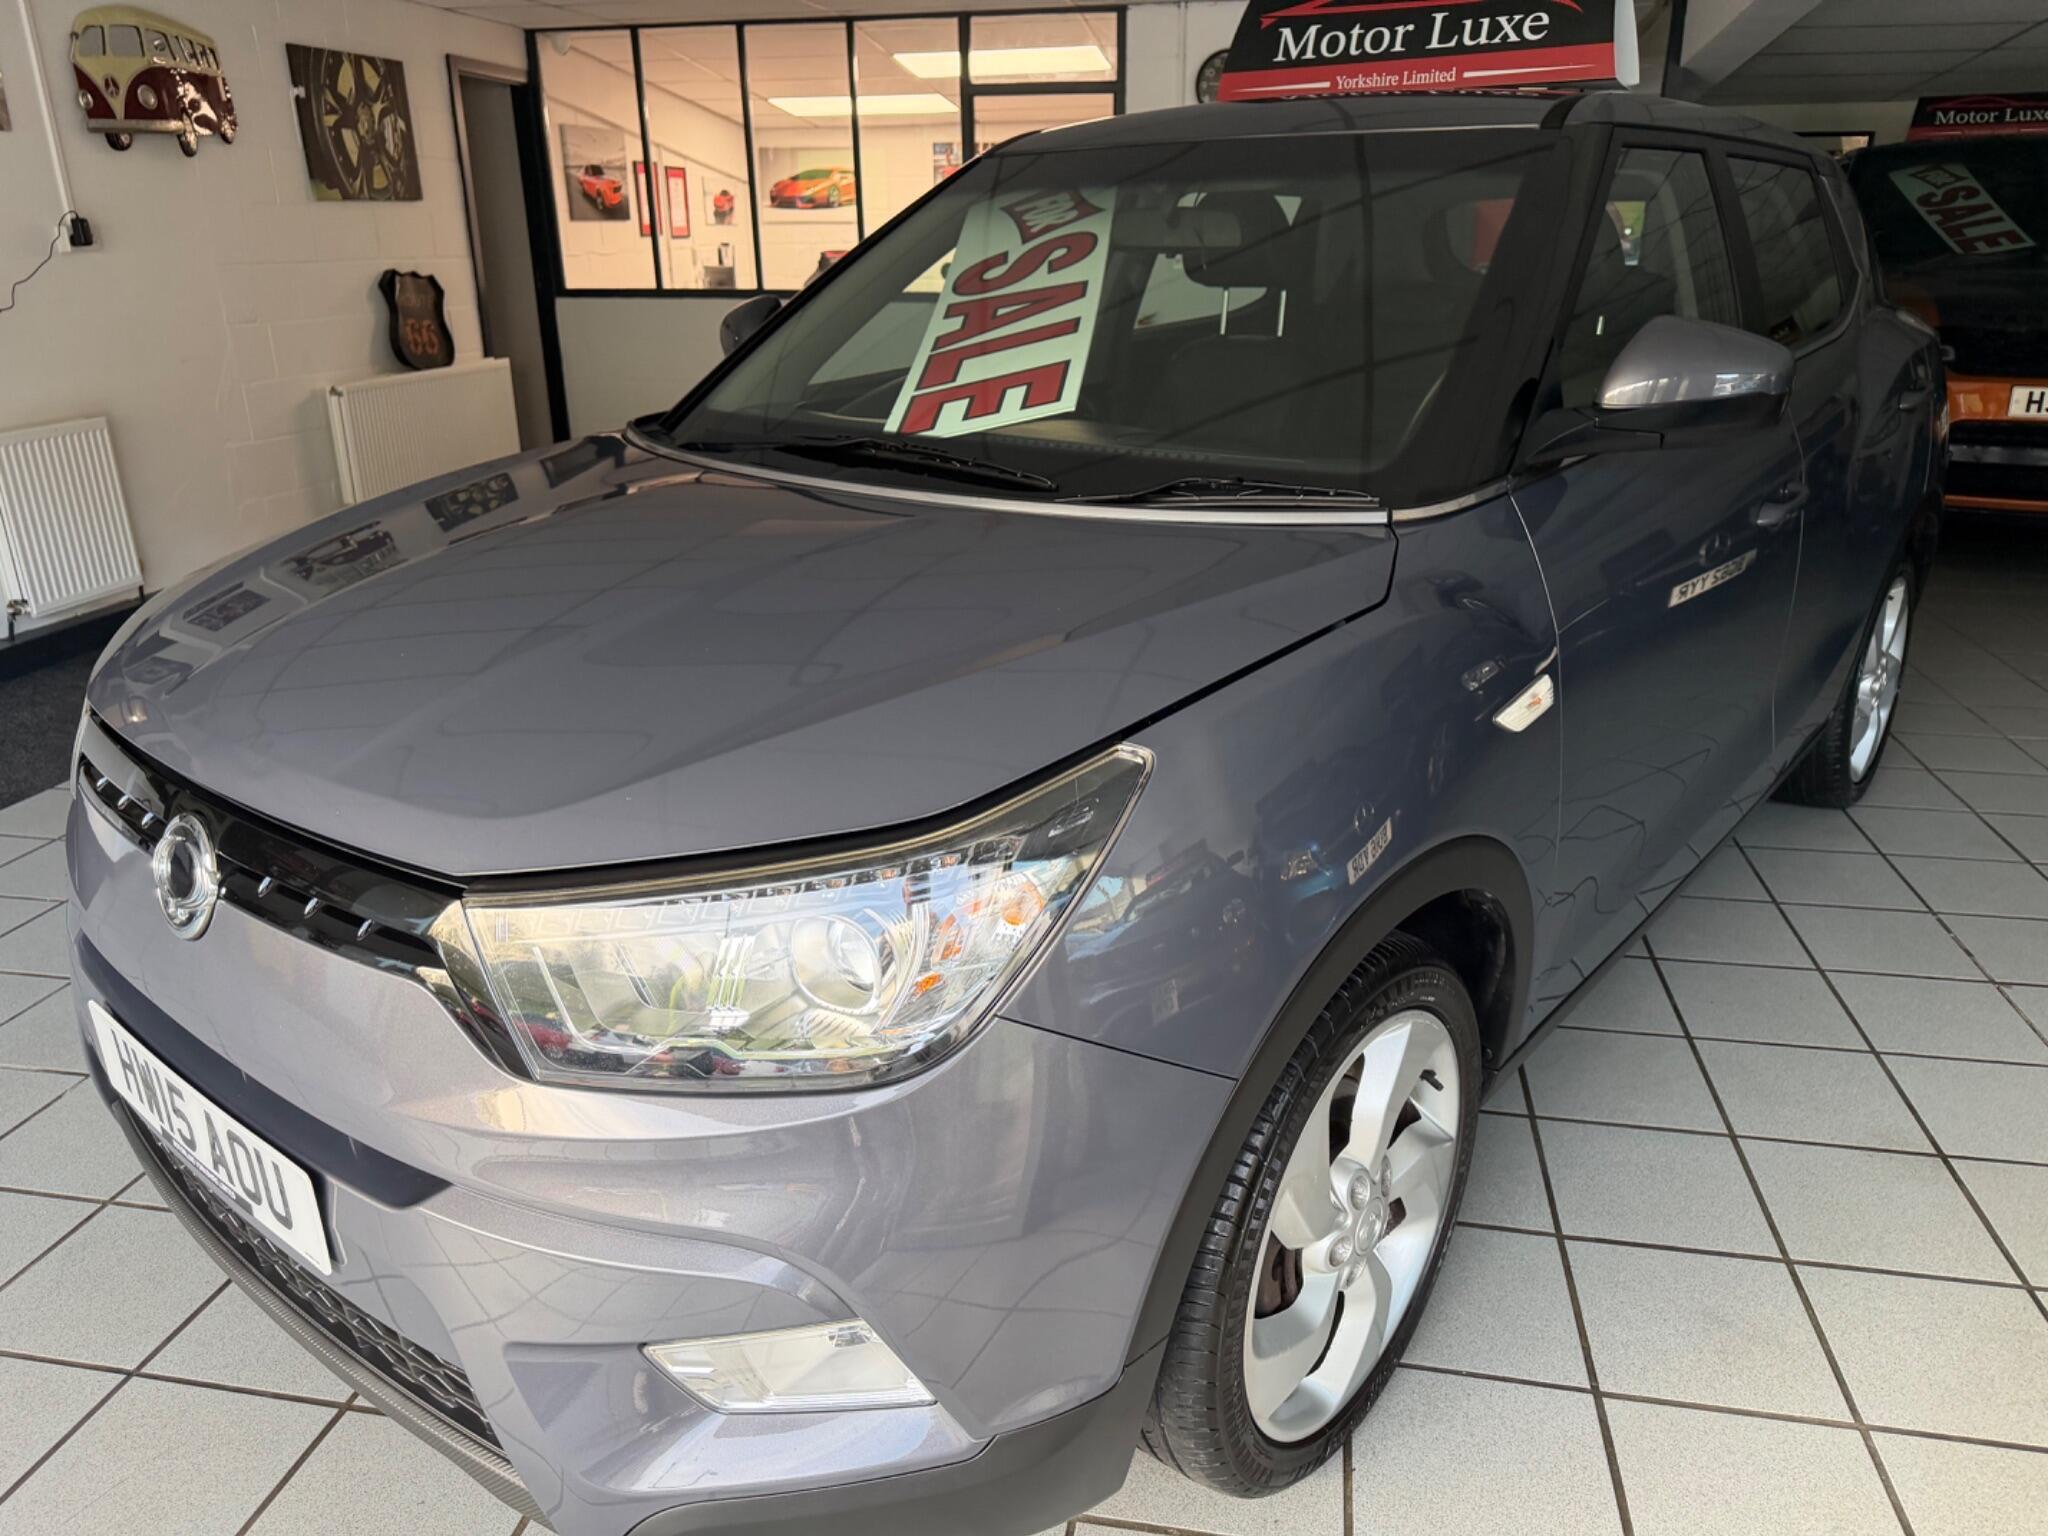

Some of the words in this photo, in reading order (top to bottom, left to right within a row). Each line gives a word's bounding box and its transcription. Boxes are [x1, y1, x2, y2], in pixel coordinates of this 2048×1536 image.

[1273, 23, 1415, 62] Motor
[1425, 11, 1550, 50] Luxe
[1335, 72, 1399, 91] Yorkshire
[1403, 67, 1457, 86] Limited
[1933, 110, 1999, 125] Motor
[1014, 191, 1080, 233] FOR
[1914, 185, 2028, 253] SALE
[899, 231, 1098, 437] SALE
[110, 1028, 198, 1153] HW15
[204, 1108, 294, 1231] AOU
